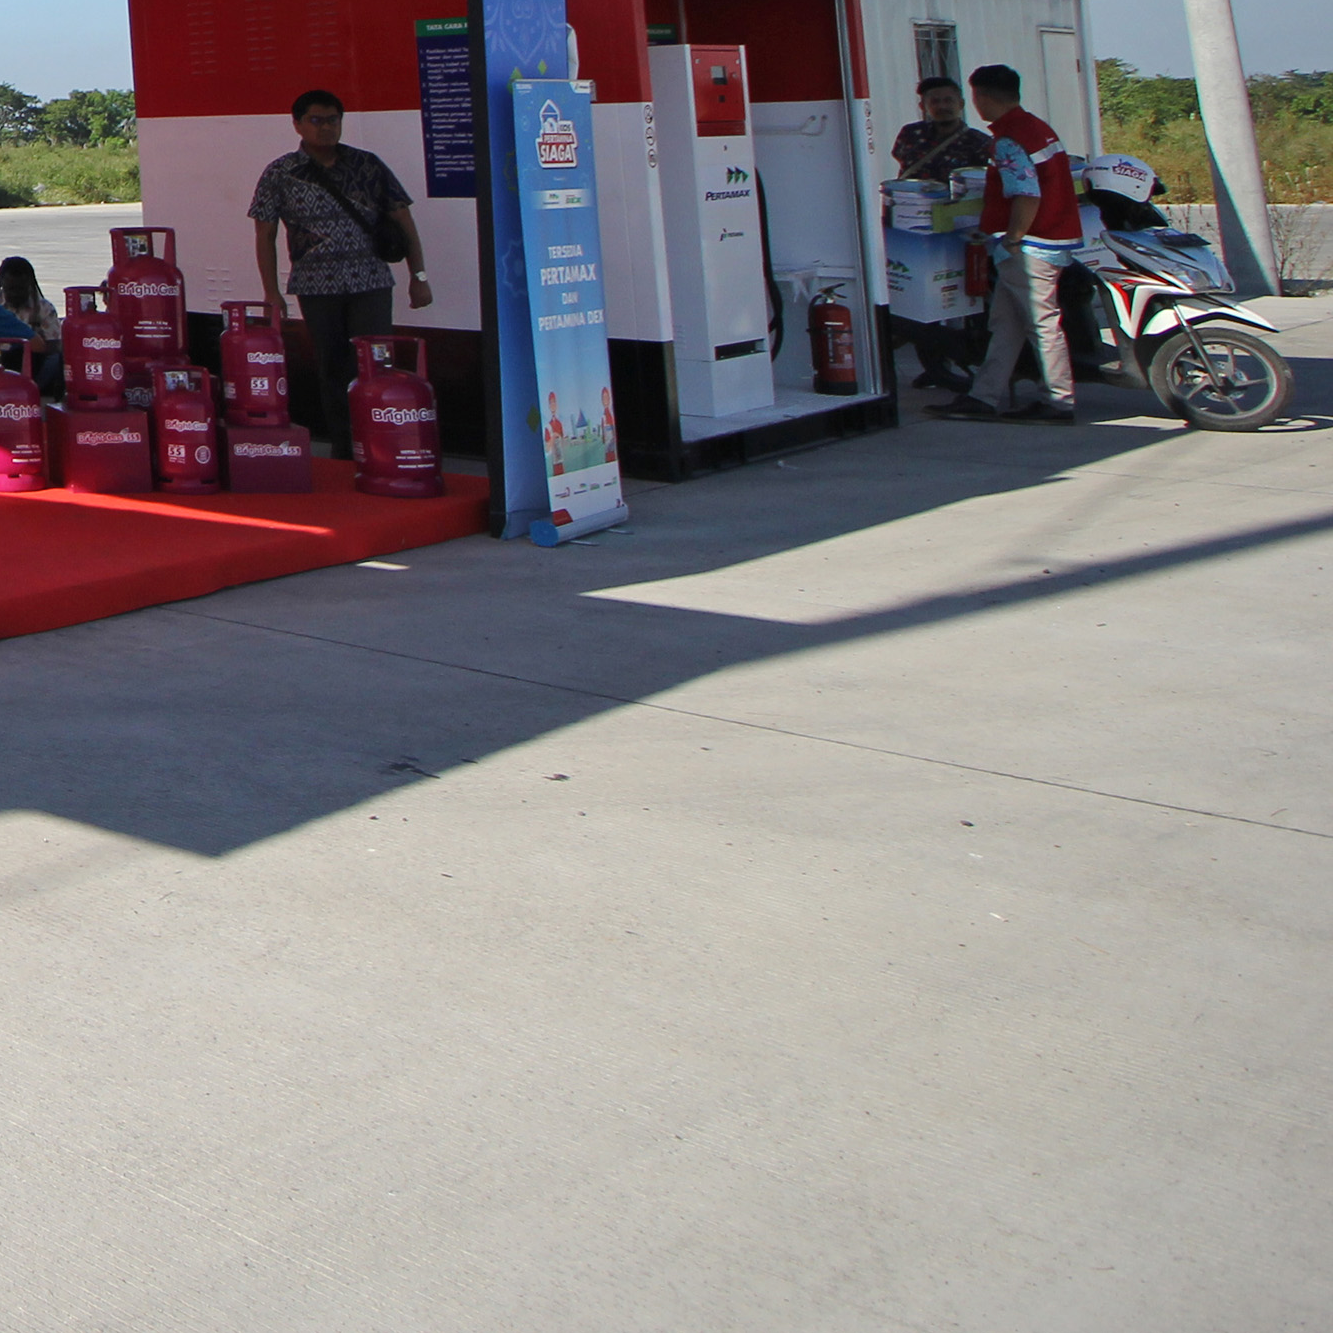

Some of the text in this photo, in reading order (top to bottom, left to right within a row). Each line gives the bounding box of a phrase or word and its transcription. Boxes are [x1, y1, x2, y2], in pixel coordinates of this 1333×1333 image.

[541, 145, 572, 161] SIAGA
[1115, 167, 1146, 182] SIAGA
[705, 189, 750, 201] PERTAMAX
[548, 244, 583, 259] TERSEDIA
[541, 264, 596, 286] PERTAMAX
[118, 282, 157, 297] Bright
[587, 309, 604, 324] DEX
[372, 407, 418, 425] Bright
[77, 431, 123, 446] Bright Gas
